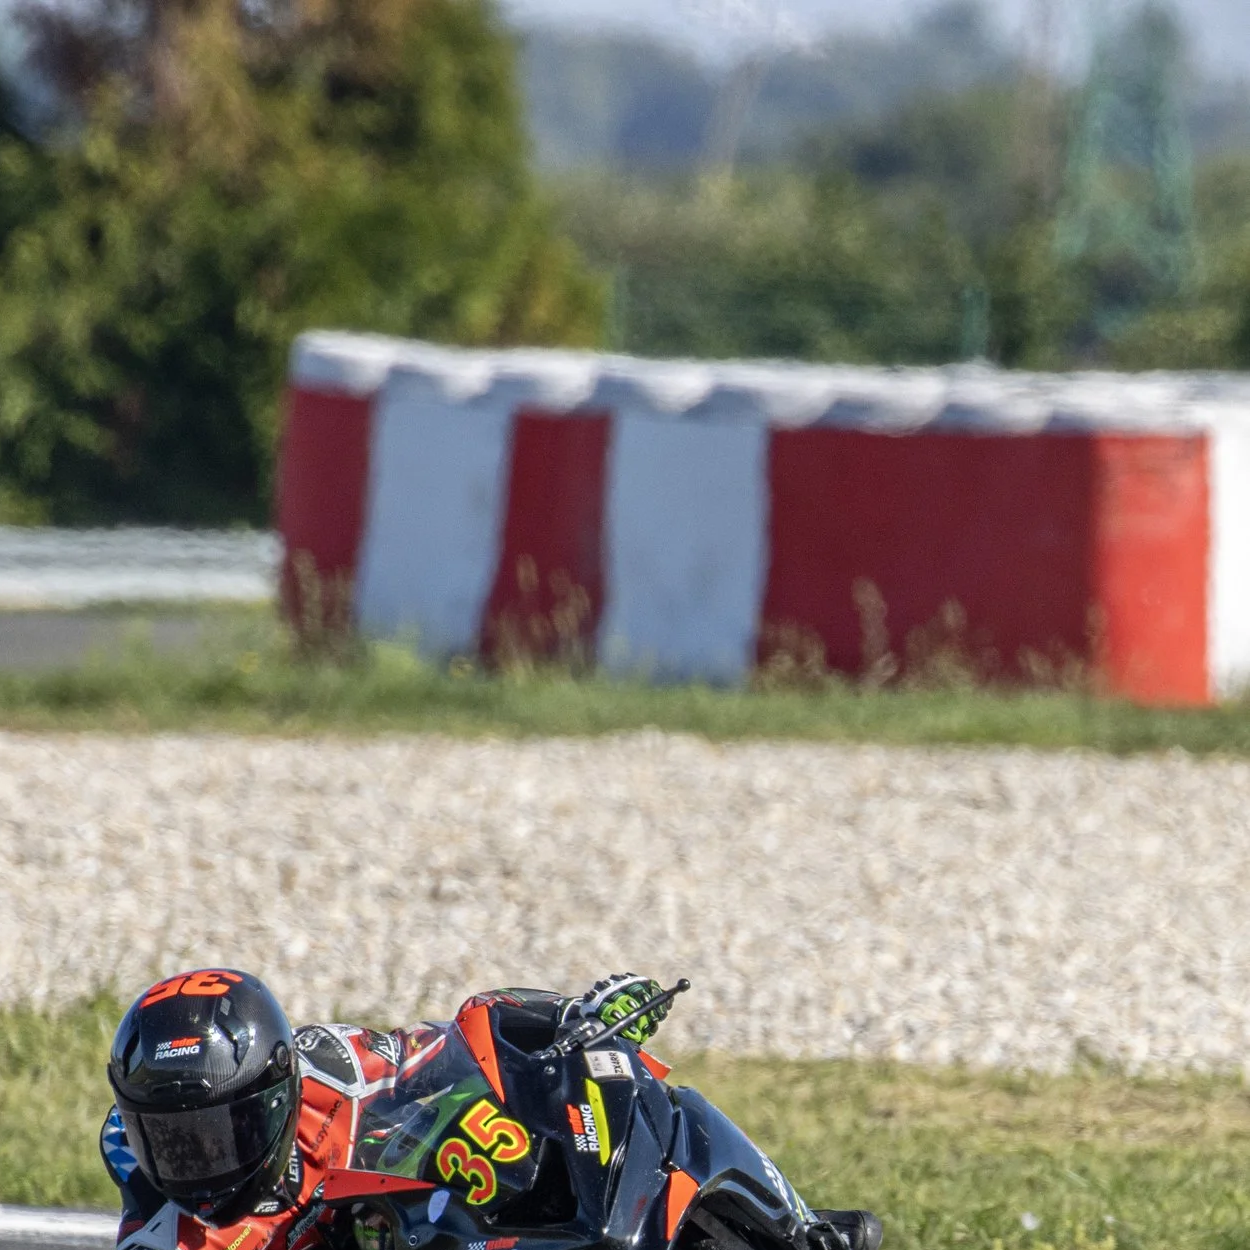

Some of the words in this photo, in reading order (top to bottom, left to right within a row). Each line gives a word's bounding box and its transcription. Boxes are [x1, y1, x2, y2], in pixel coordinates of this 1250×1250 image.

[154, 1045, 200, 1061] RACING
[436, 1099, 531, 1205] 35
[579, 1103, 601, 1152] RACING
